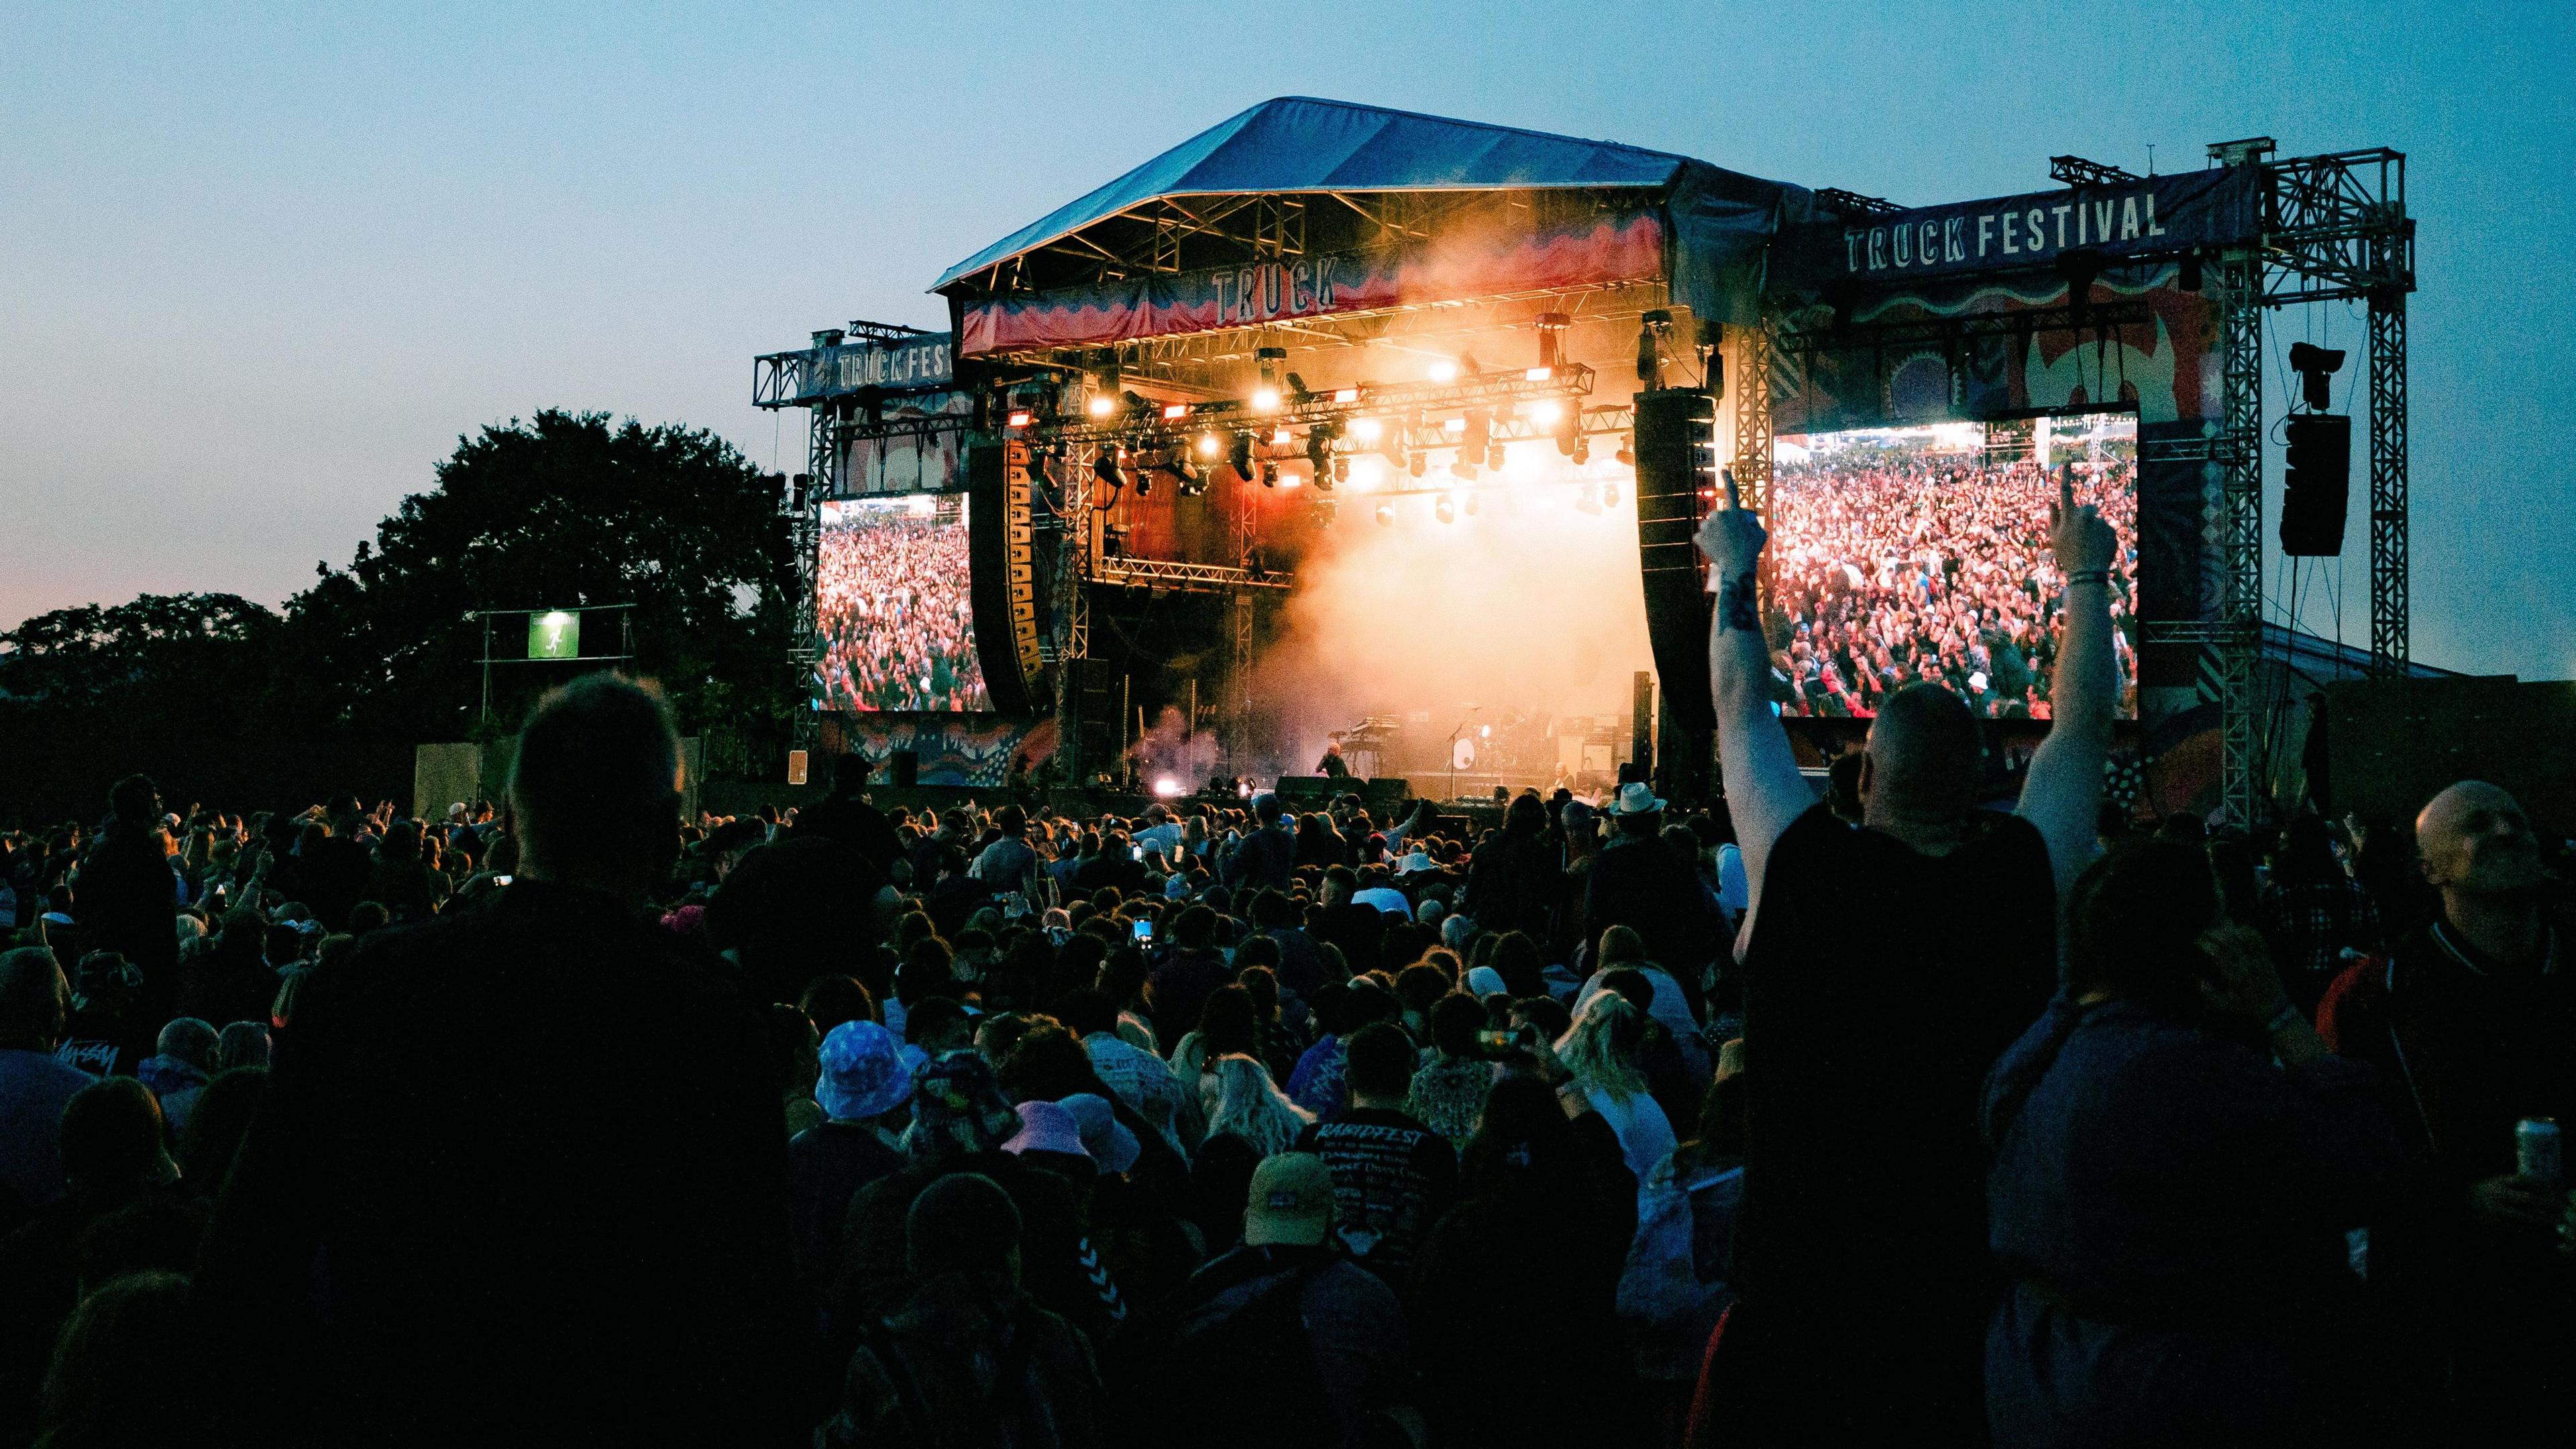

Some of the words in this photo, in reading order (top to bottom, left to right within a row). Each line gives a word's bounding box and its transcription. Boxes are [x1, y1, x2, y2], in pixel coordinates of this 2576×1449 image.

[1843, 216, 1965, 272] TRUCK
[1978, 193, 2165, 257] FESTIVAL
[1212, 256, 1338, 325] TRUCK
[838, 347, 903, 388] TRUCK
